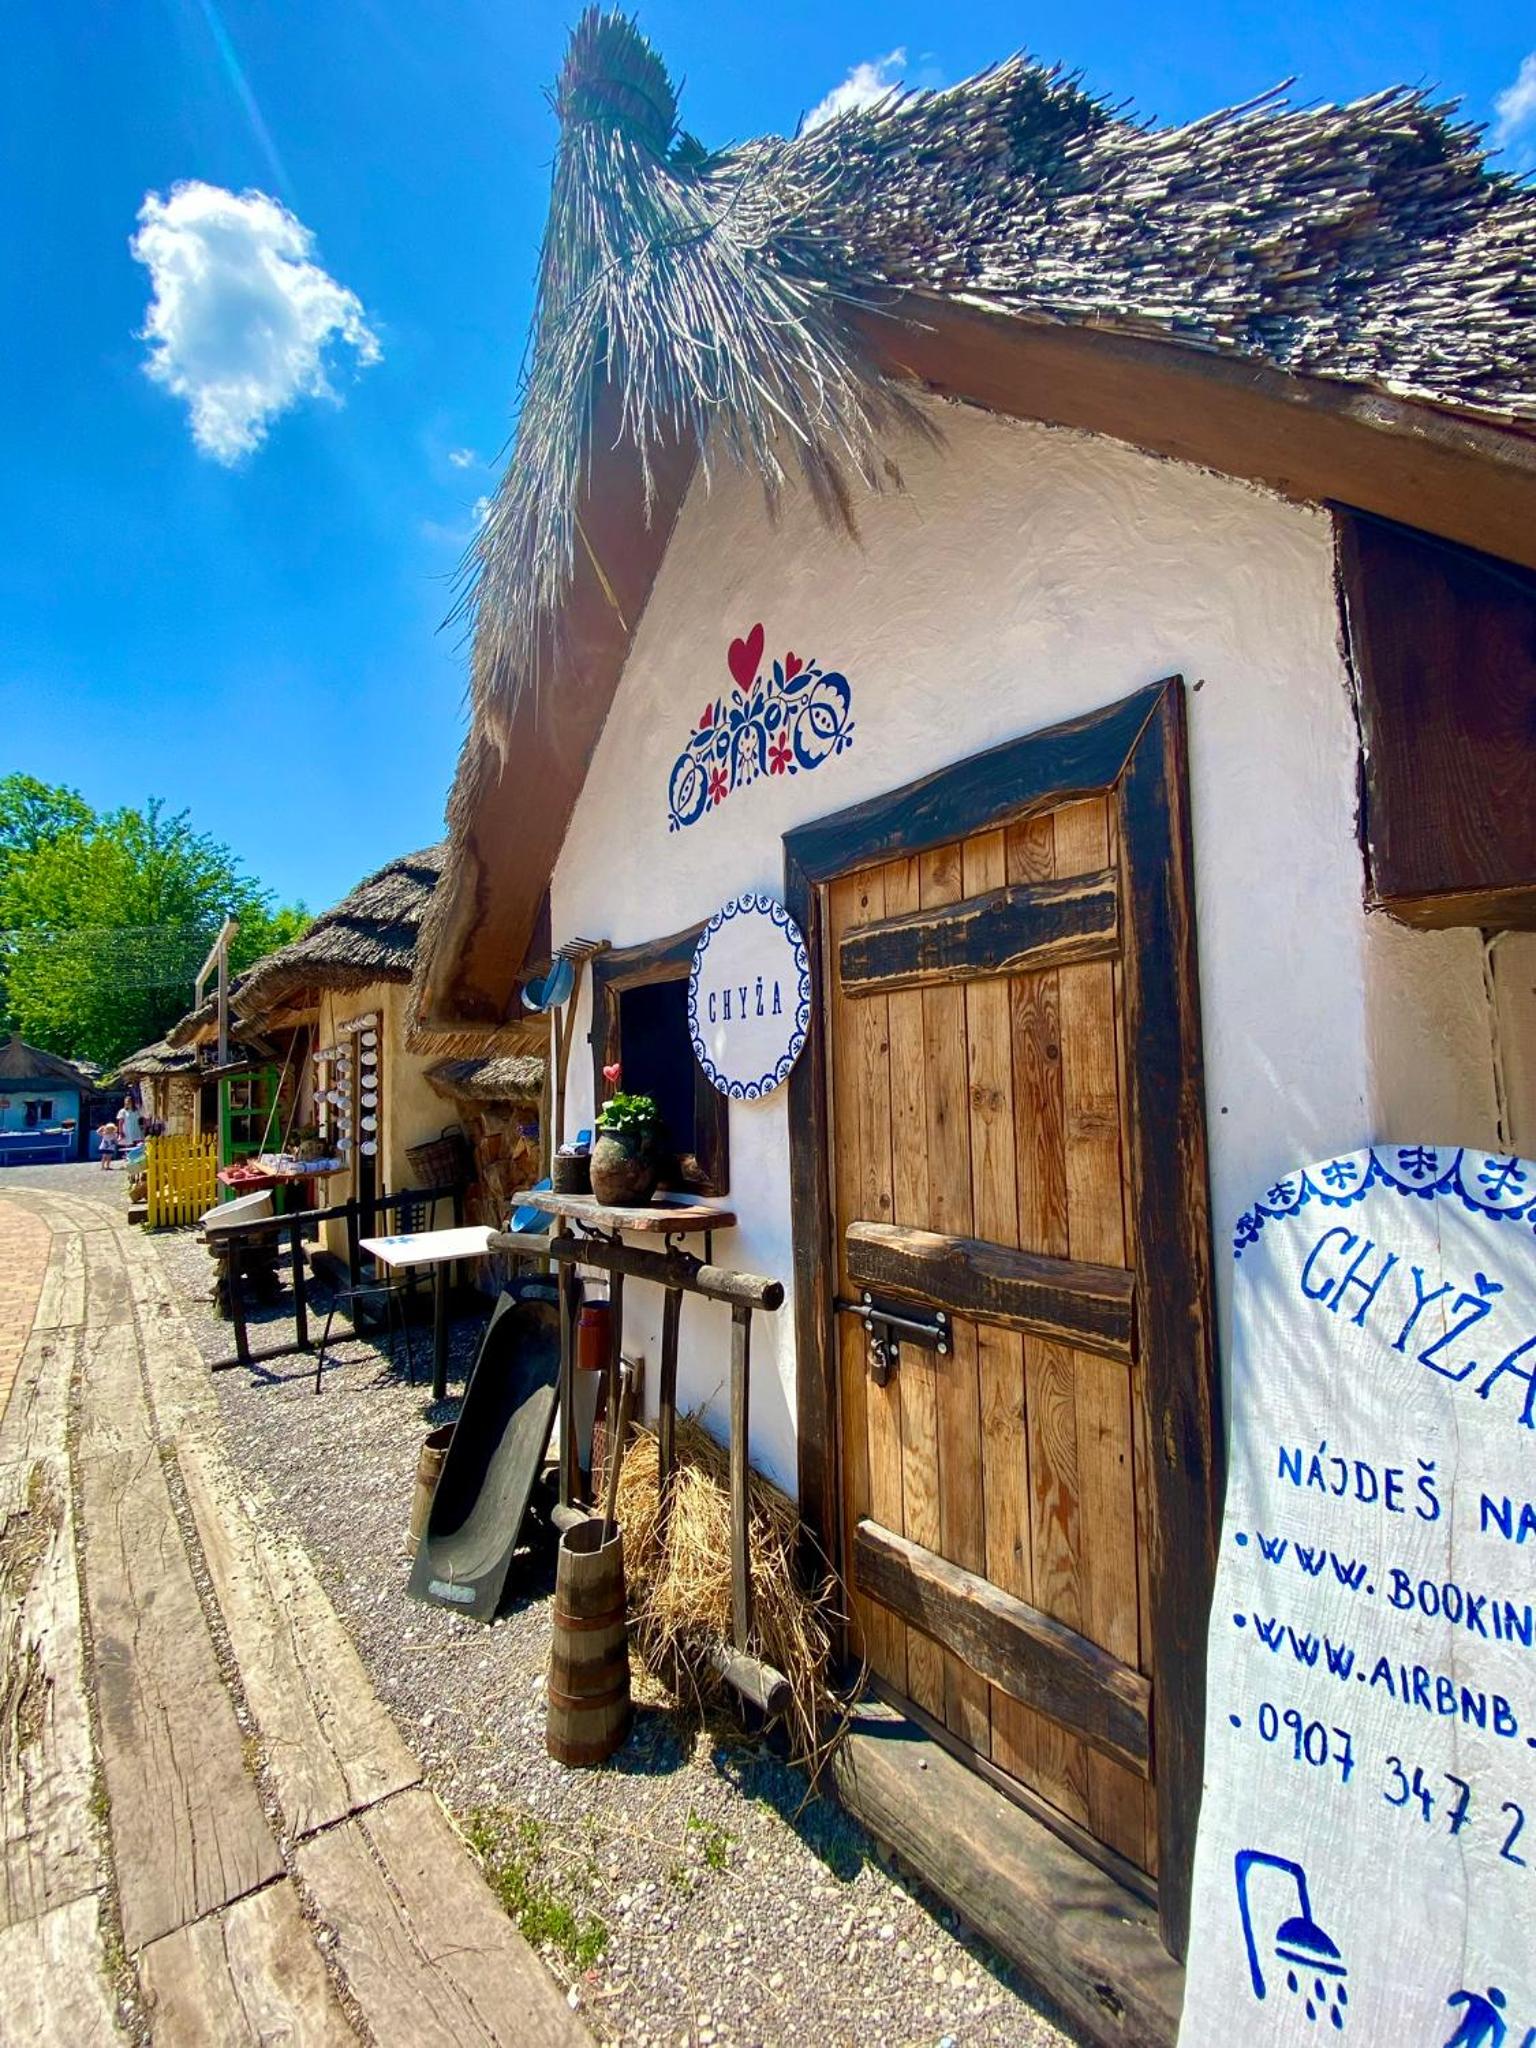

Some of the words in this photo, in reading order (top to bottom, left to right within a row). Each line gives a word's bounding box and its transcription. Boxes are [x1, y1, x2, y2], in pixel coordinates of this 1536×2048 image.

[708, 976, 783, 1023] CHYŽA
[1300, 1226, 1536, 1430] CHYŽA
[1278, 1440, 1441, 1522] NÁJDEŠ
[1480, 1495, 1536, 1545] NA
[1256, 1531, 1536, 1648] WWW.BOOKIN
[1258, 1702, 1355, 1784] 0907
[1383, 1756, 1471, 1836] 347
